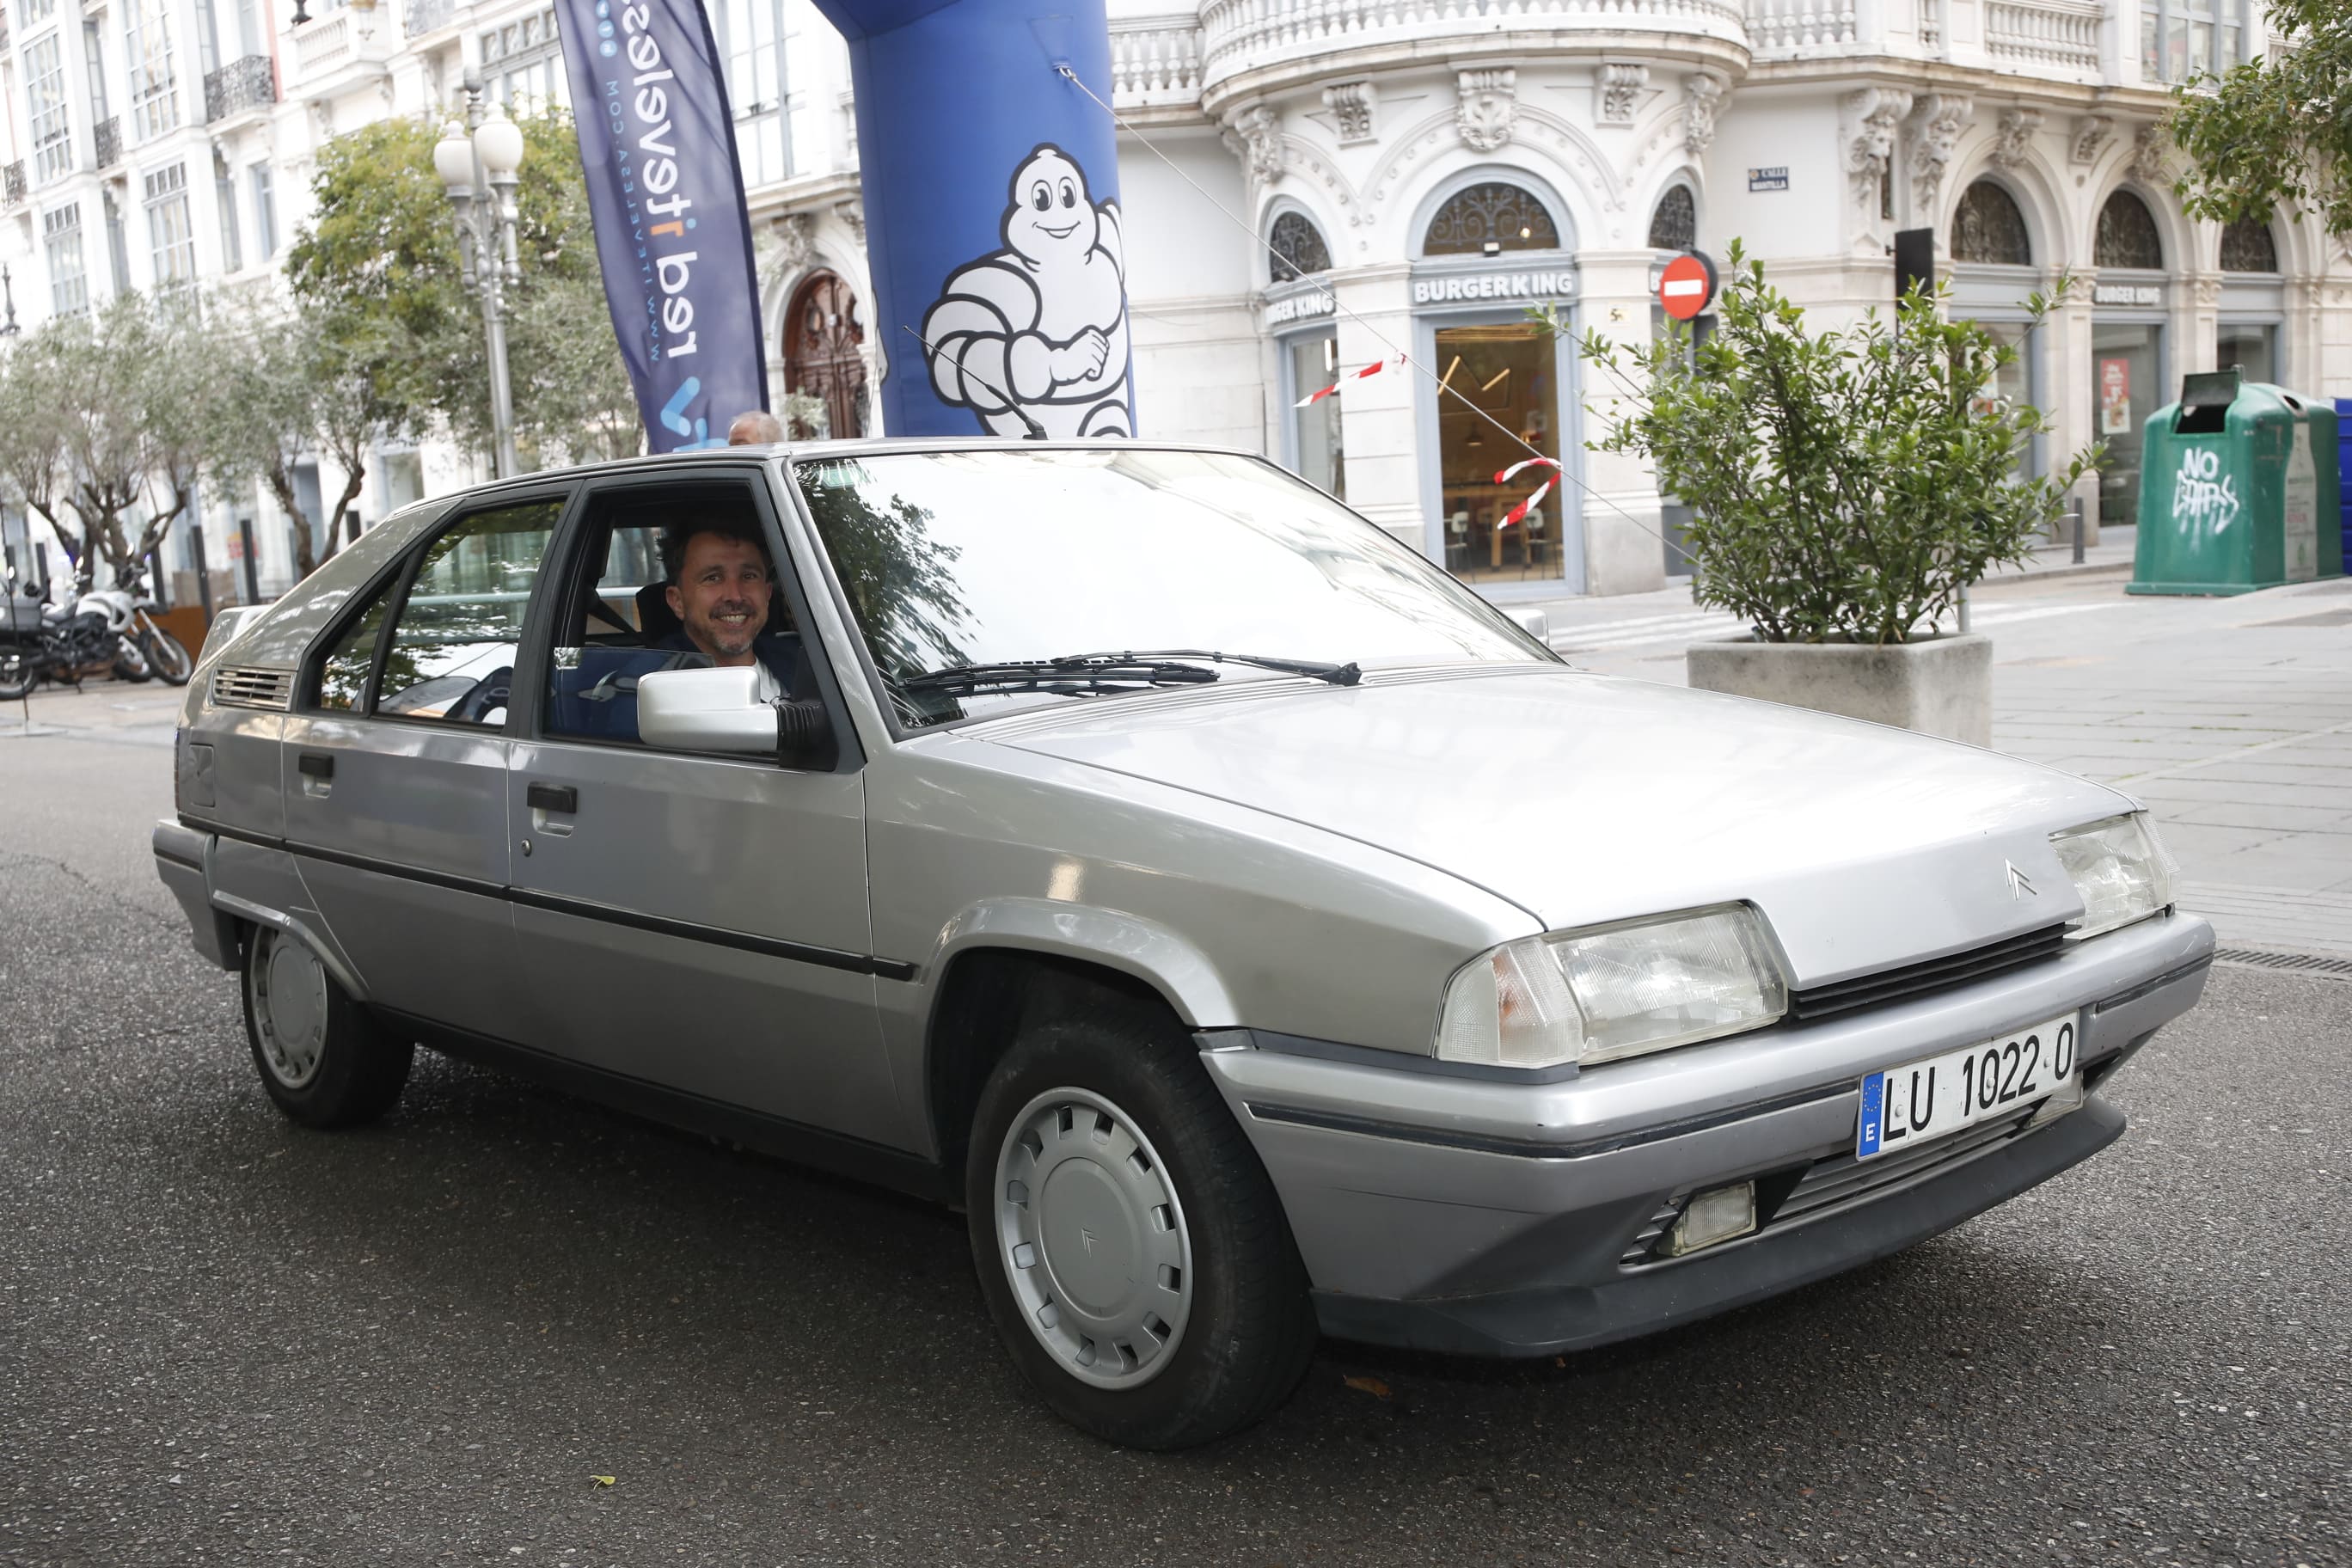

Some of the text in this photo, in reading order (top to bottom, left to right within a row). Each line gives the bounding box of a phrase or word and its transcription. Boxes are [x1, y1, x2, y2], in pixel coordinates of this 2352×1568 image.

[1414, 273, 1573, 303] BURGER KING
[1295, 292, 1334, 317] KING
[2184, 447, 2220, 480] NO
[1883, 1066, 1936, 1142] LU
[1963, 1034, 2040, 1118] 1022
[1865, 1122, 1877, 1142] E
